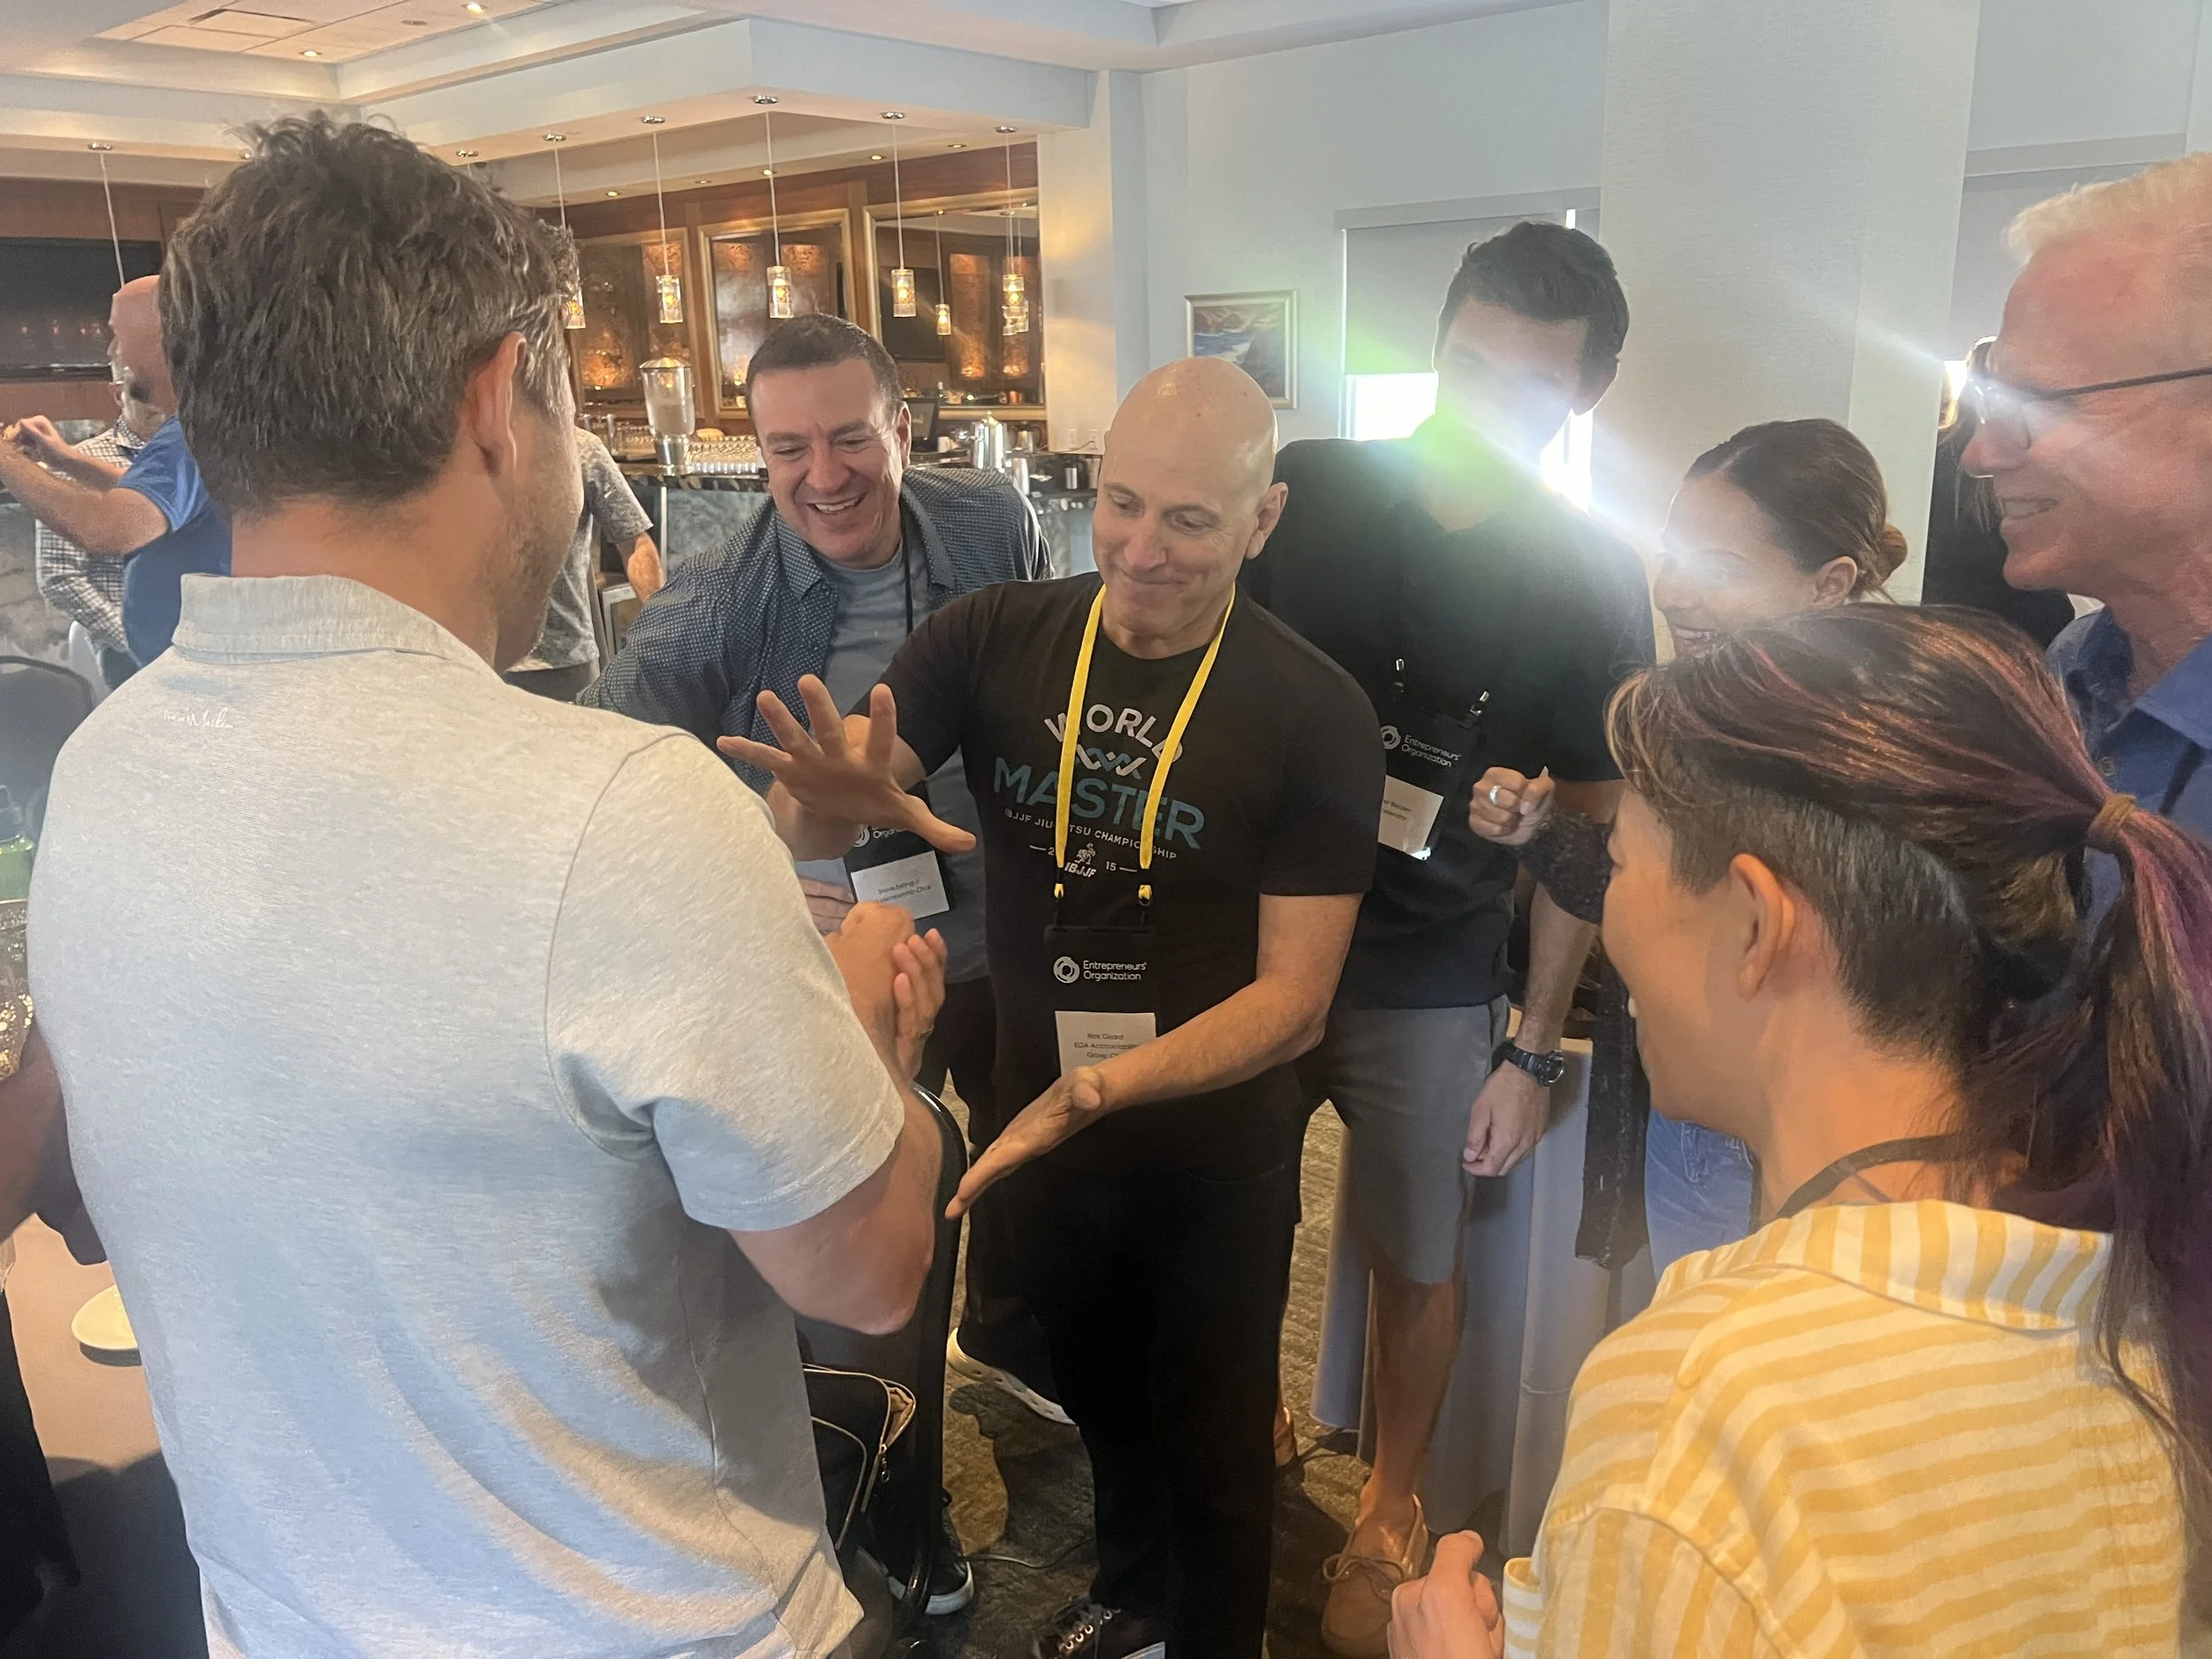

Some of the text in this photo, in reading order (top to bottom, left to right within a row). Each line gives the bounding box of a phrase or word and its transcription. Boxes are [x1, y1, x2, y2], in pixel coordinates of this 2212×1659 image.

[1044, 703, 1183, 763] WORLD
[1401, 743, 1452, 768] Organization
[993, 757, 1204, 849] MASTER
[1004, 807, 1033, 823] IBJJF
[1094, 830, 1178, 860] CHAMPIOSHIP
[1064, 862, 1097, 879] IBJJF
[1083, 971, 1141, 982] Organization
